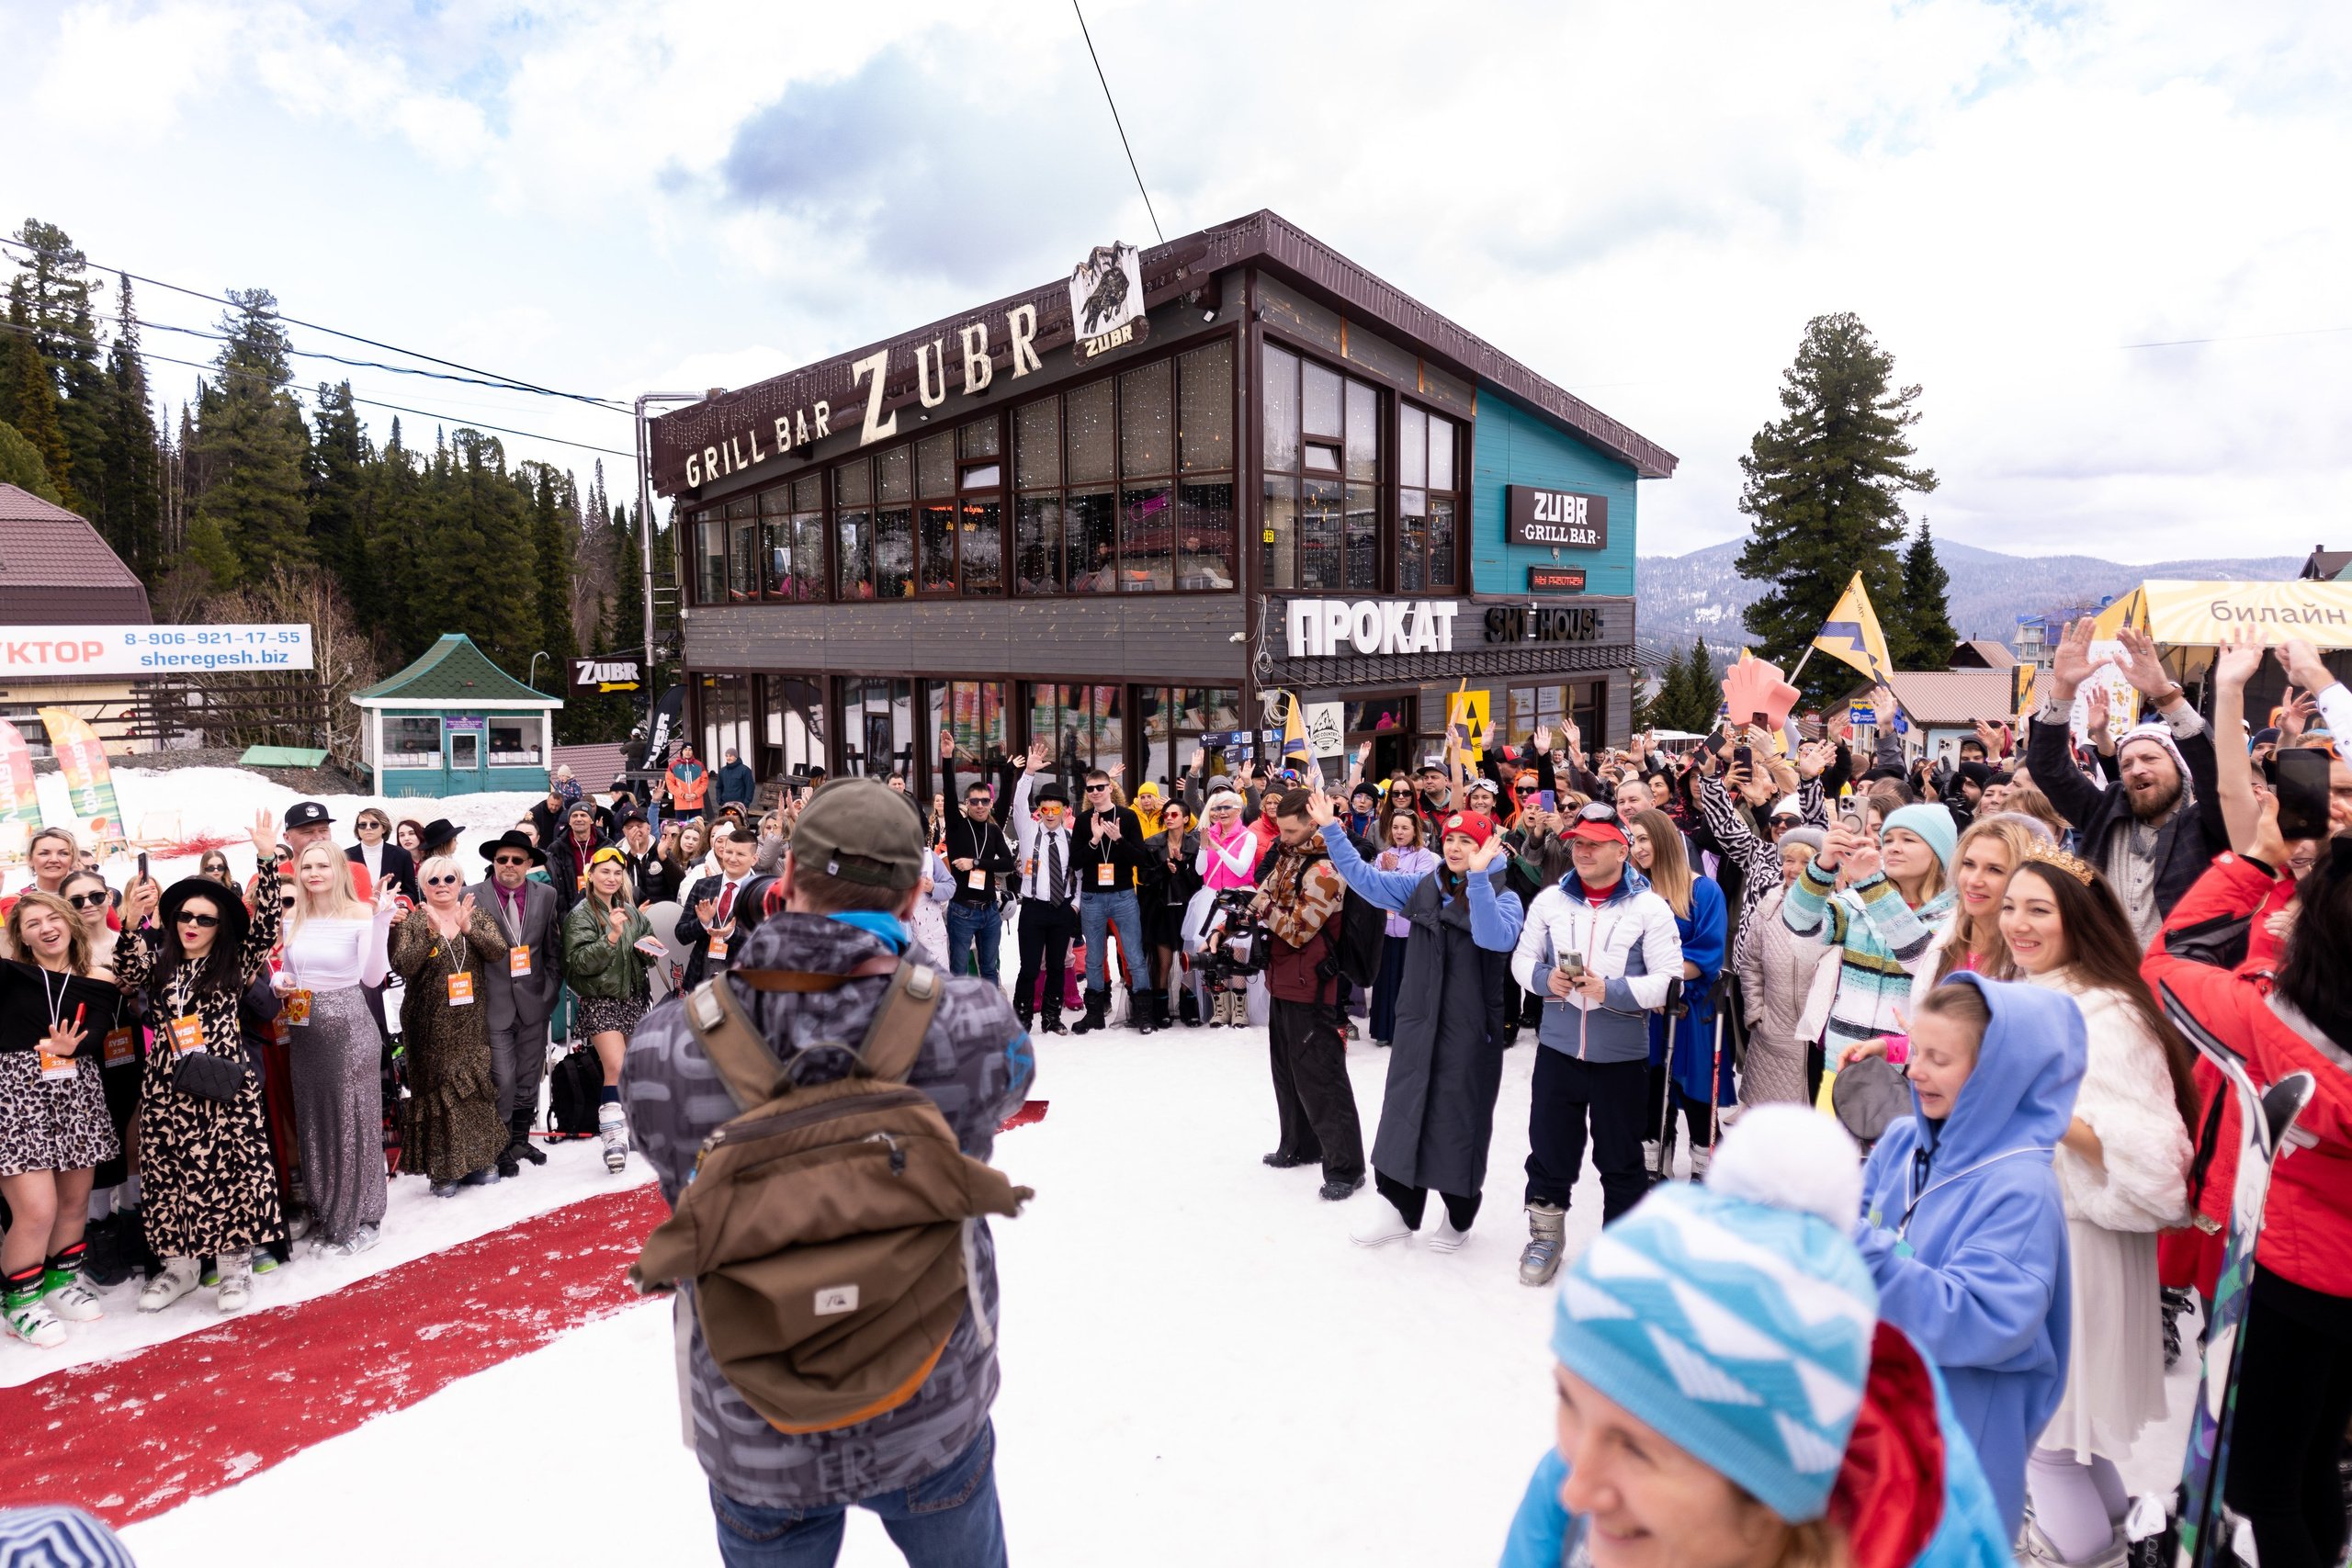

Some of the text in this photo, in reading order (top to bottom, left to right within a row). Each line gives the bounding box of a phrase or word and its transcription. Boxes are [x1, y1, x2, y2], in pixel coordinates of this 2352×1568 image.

[1085, 323, 1135, 359] ZUBR
[852, 304, 1043, 446] ZUBR
[684, 399, 832, 489] GRILL BAR
[1533, 491, 1589, 525] ZUBR
[1287, 599, 1459, 658] ПРОКАТ
[1485, 607, 1605, 643] SKI HOUSE
[2211, 600, 2346, 625] билайн
[0, 641, 105, 664] КТОР
[140, 649, 289, 669] sheregesh.biz
[576, 660, 640, 684] ZUBR
[108, 1037, 128, 1048] AYS!
